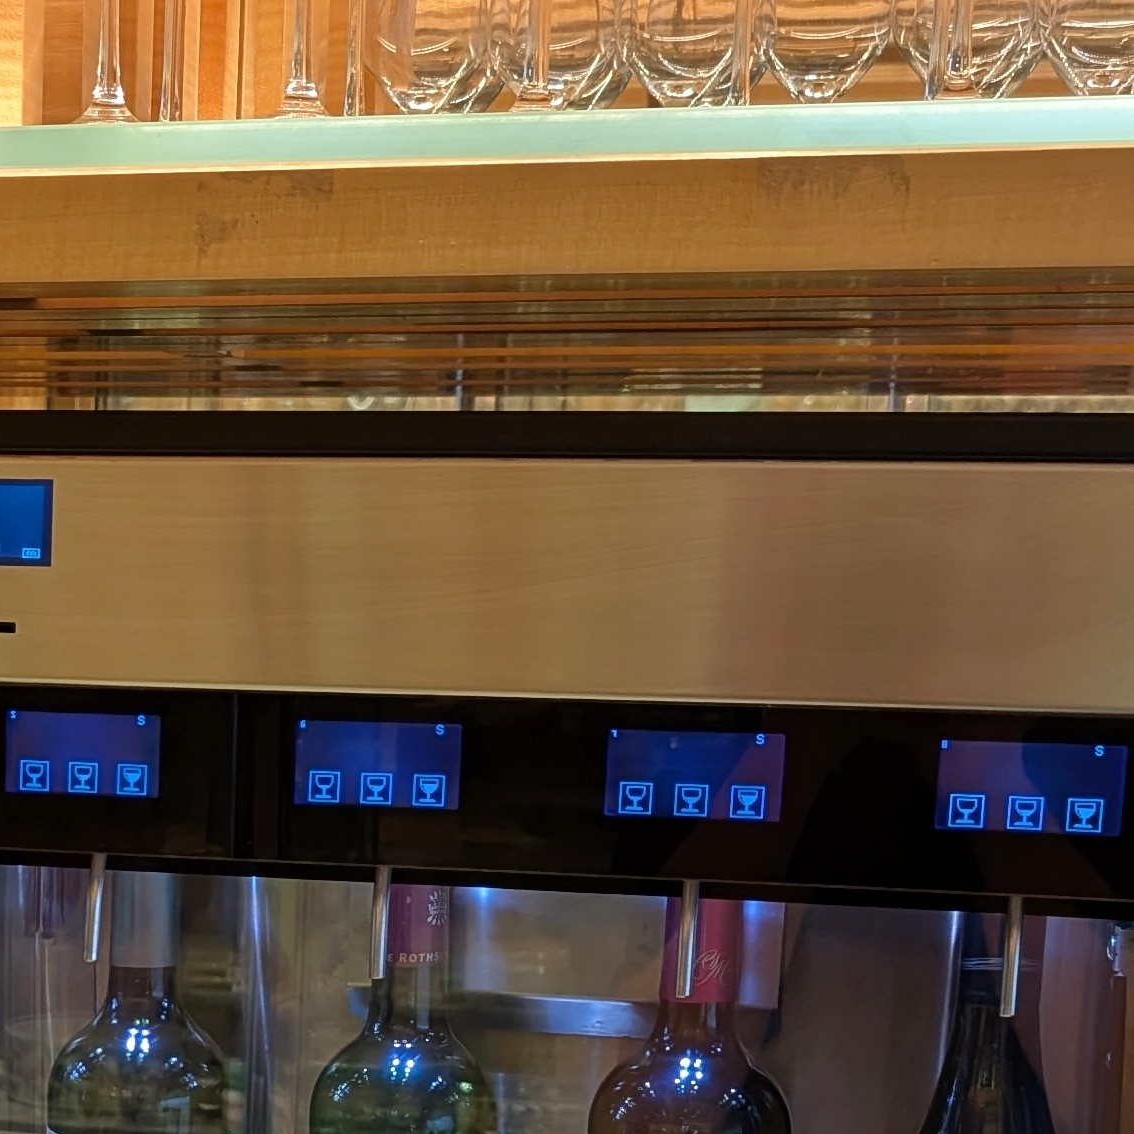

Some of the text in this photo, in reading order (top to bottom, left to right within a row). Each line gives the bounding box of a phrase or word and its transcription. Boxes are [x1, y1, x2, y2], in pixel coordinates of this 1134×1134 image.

[137, 714, 146, 726] S
[434, 723, 444, 735] S
[755, 733, 766, 745] S
[1094, 745, 1105, 757] S
